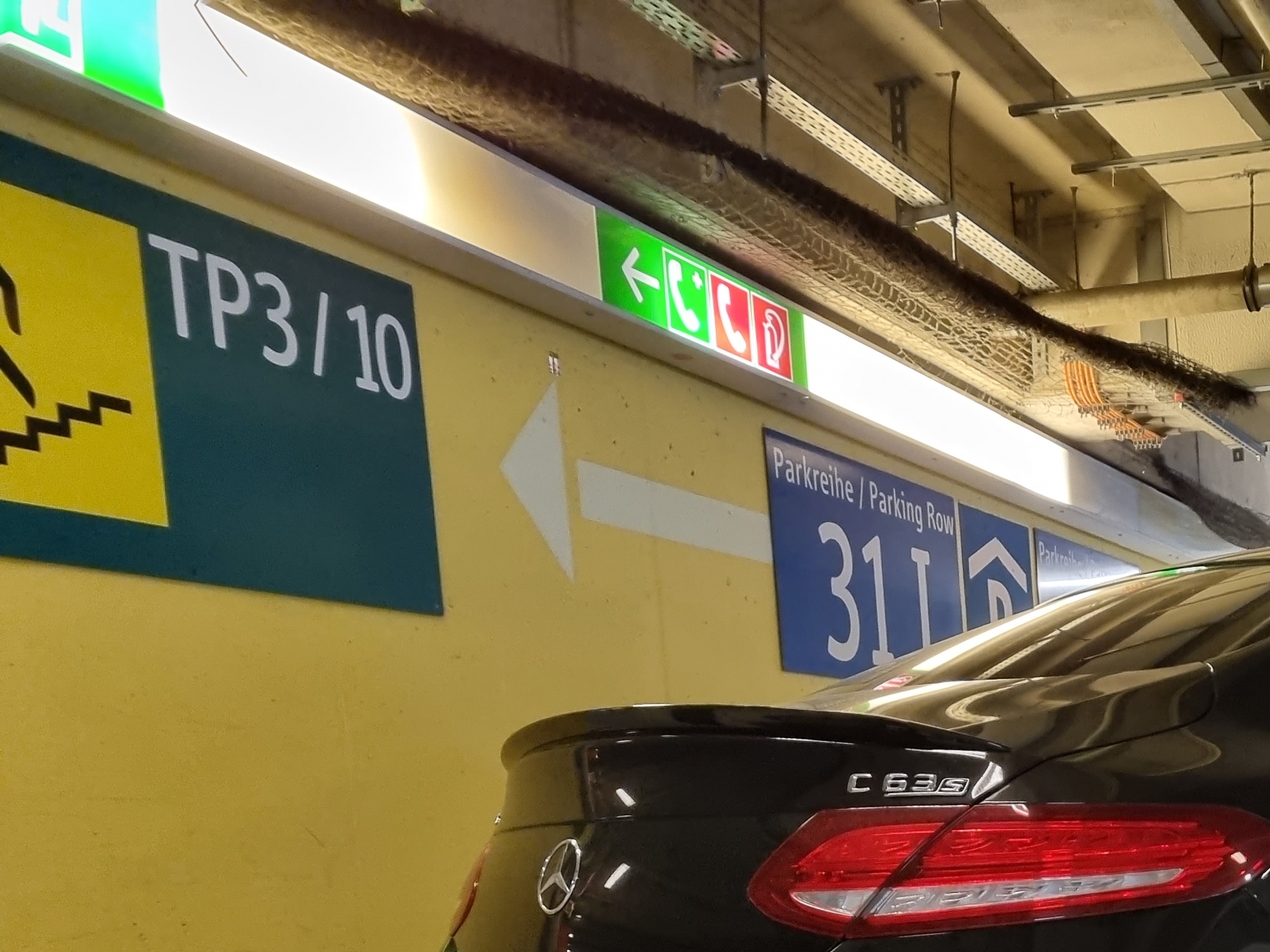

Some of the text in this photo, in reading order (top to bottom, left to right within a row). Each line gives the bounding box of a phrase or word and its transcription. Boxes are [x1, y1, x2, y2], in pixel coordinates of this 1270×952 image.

[148, 233, 298, 367] TP3
[346, 304, 412, 401] 10
[773, 446, 854, 503] Parkreihe
[869, 481, 924, 533] Parking
[927, 502, 955, 536] Row
[818, 521, 895, 665] 31
[847, 773, 872, 793] C
